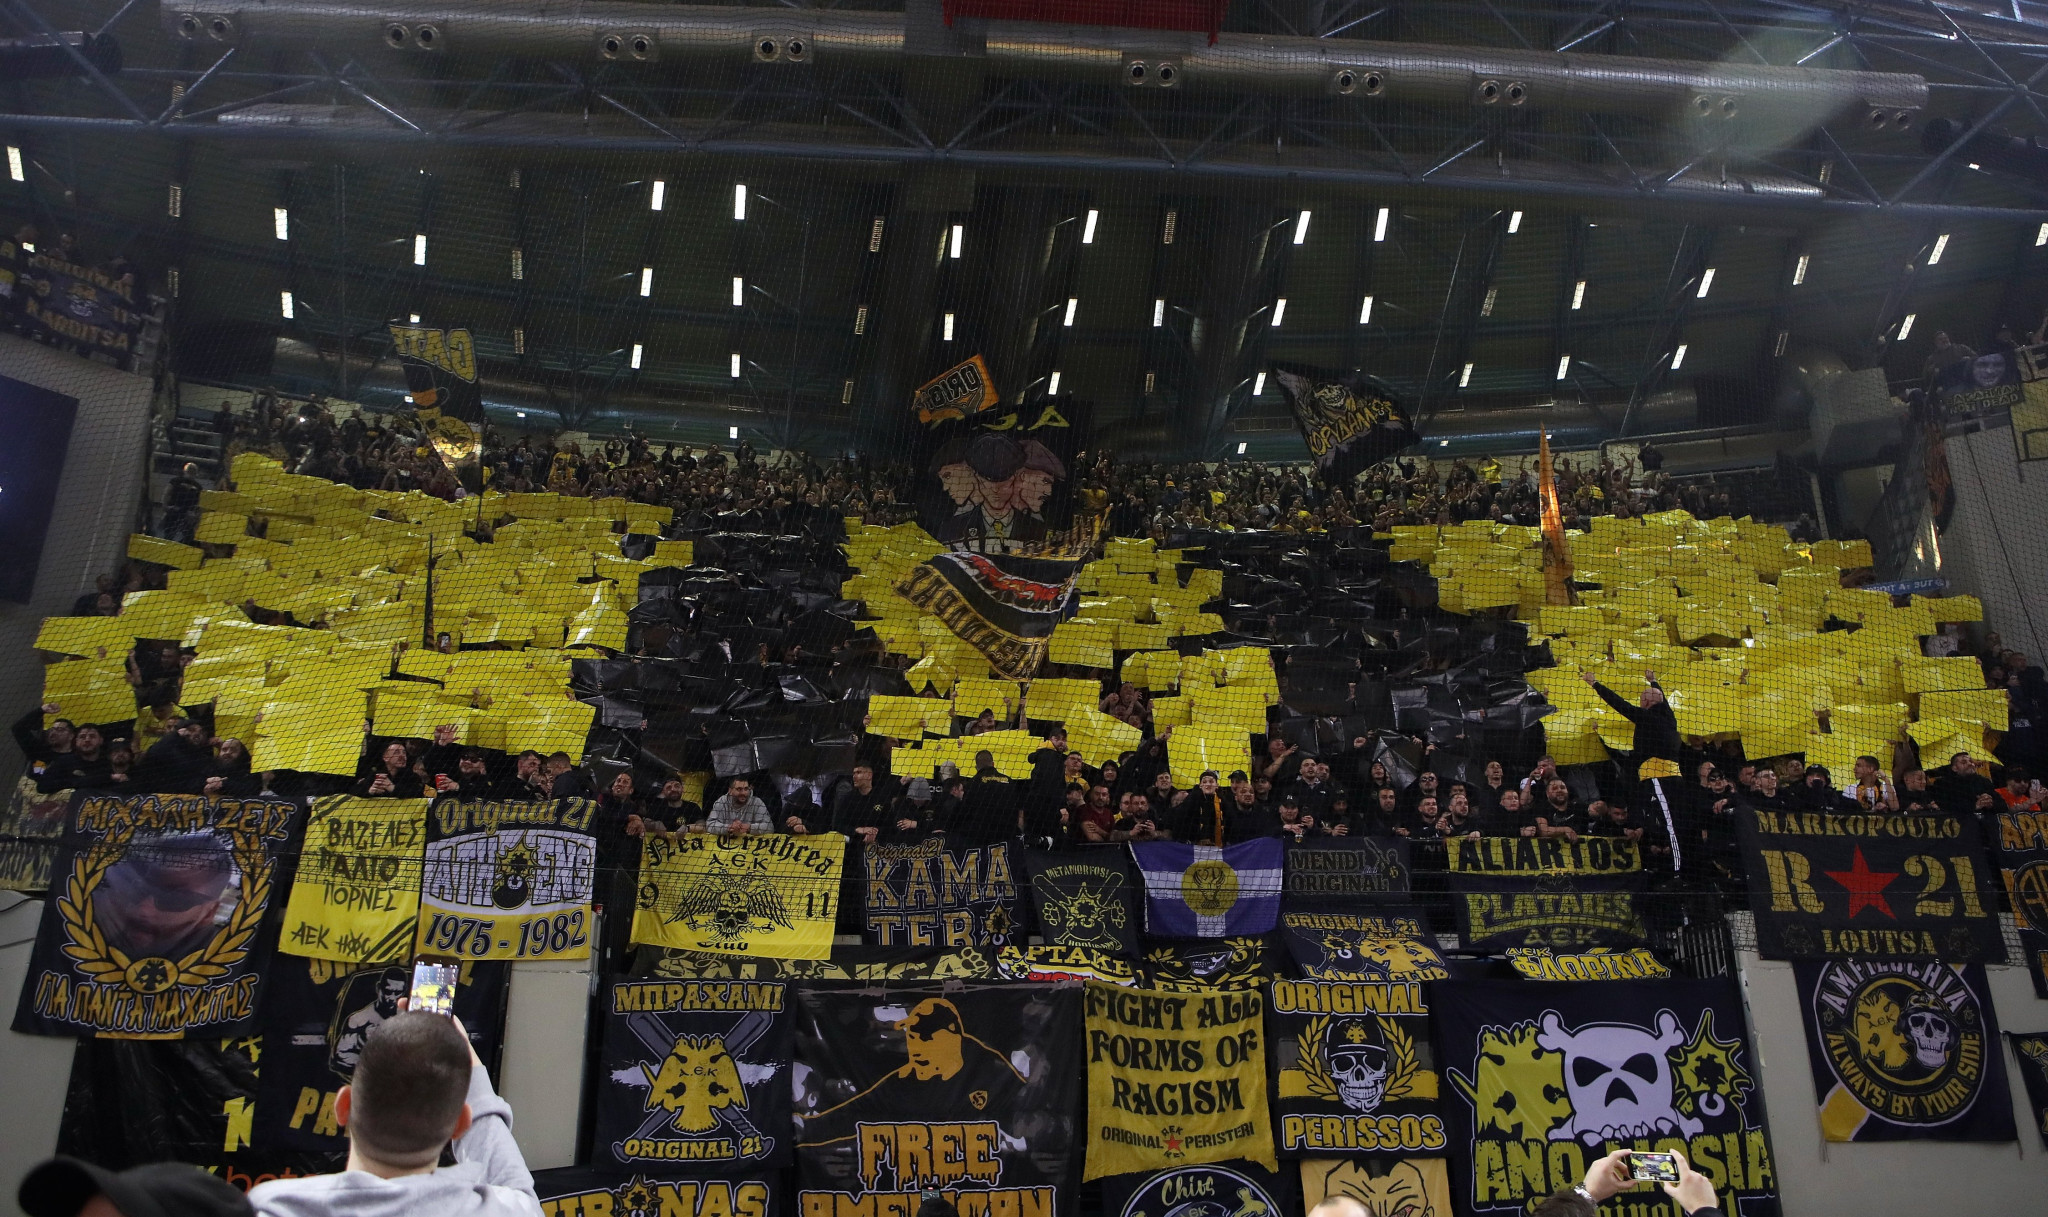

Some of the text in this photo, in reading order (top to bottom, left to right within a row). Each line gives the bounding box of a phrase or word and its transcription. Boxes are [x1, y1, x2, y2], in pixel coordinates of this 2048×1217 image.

[435, 796, 597, 836] Original 21
[1754, 810, 1961, 838] MARKOPOULO
[1289, 850, 1367, 872] MENIDI
[1458, 836, 1634, 871] ALIARTOS
[866, 844, 1017, 908] KAMA
[1288, 872, 1389, 893] ORIGINAL
[1904, 854, 1988, 918] 21
[639, 883, 659, 909] 9
[424, 912, 495, 956] 1975
[516, 910, 588, 957] 1982
[1284, 913, 1423, 937] ORIGINAL 21
[1822, 929, 1938, 956] LOUTSA
[1087, 985, 1261, 1030] FIGHT ALL
[1273, 981, 1428, 1014] ORIGINAL
[1090, 1029, 1258, 1072] FORMS OF
[1826, 1033, 1886, 1108] ALWAYS
[1891, 1095, 1916, 1117] BY
[1111, 1075, 1245, 1116] RACISM
[624, 1136, 762, 1159] ORIGINAL 21
[1101, 1126, 1164, 1149] ORIGINAL
[1185, 1121, 1255, 1149] PERISTERI
[1284, 1115, 1446, 1149] PERISSOS
[859, 1122, 1000, 1190] FREE
[1474, 1138, 1586, 1204] ANO
